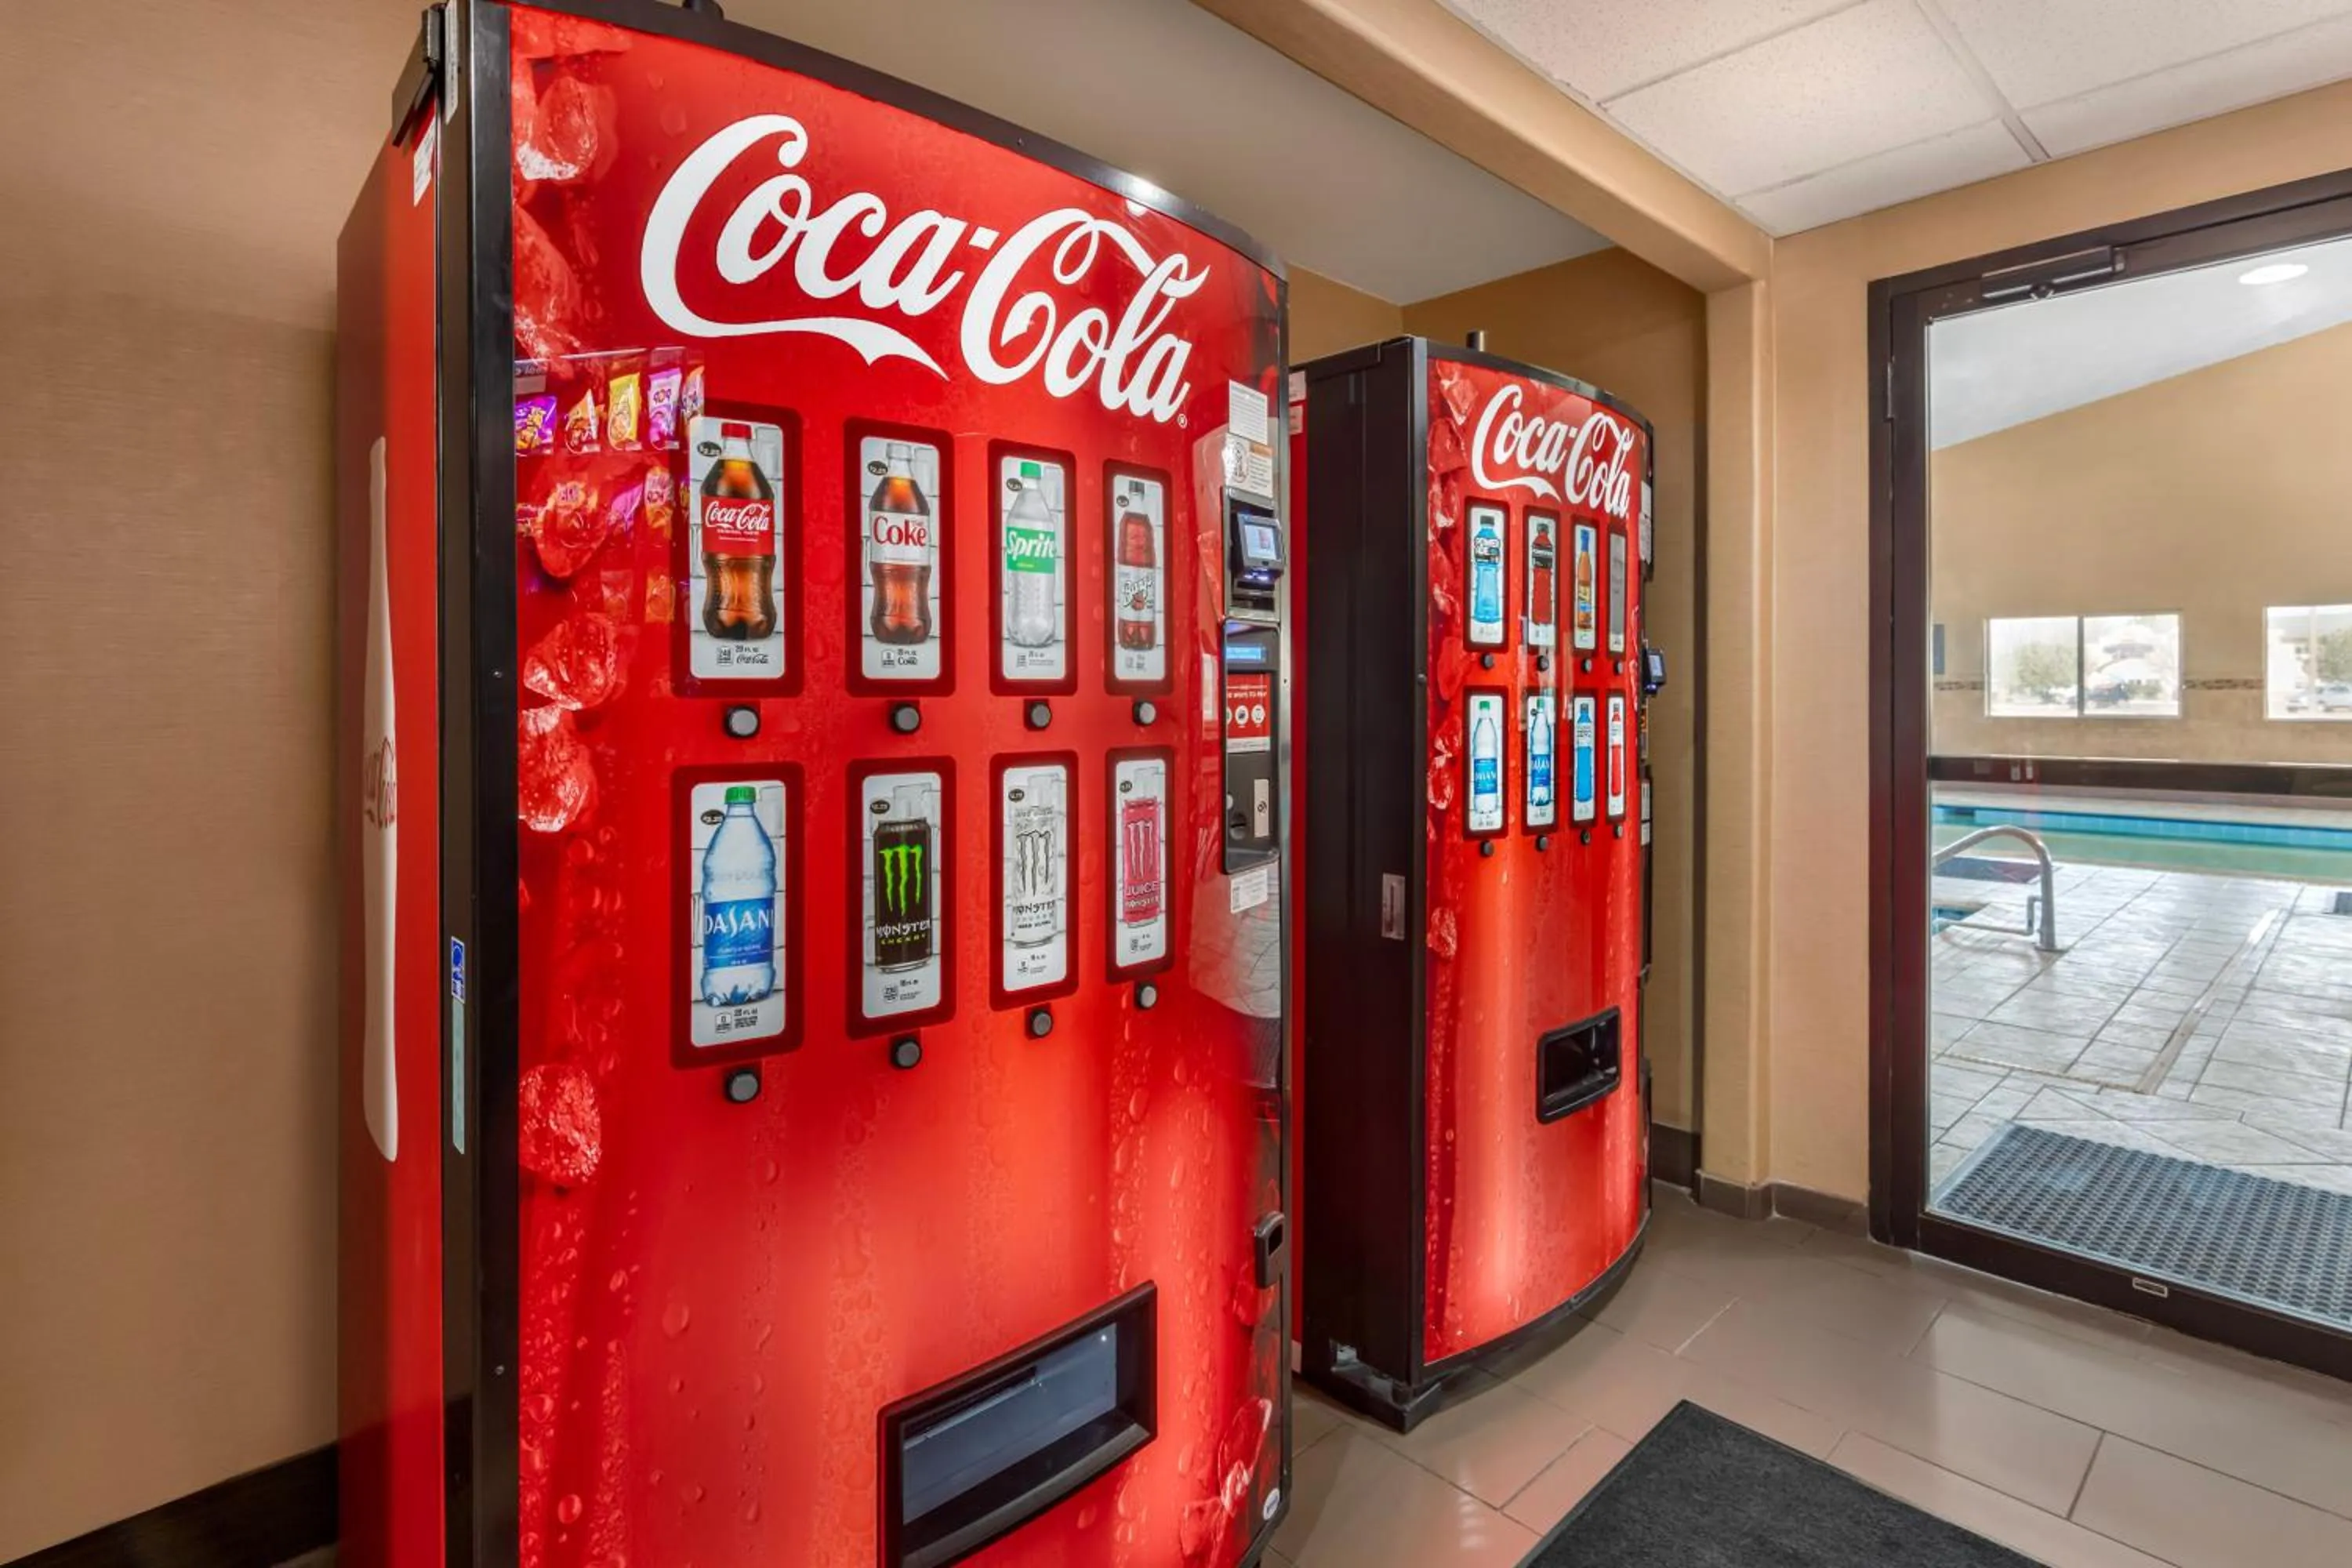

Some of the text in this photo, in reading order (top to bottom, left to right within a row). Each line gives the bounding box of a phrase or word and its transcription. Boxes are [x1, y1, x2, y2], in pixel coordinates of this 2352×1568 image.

[640, 113, 1210, 425] Coca-Cola
[1472, 384, 1634, 517] Coca-Cola
[706, 501, 771, 531] Coca-Cola
[873, 515, 927, 546] Coke
